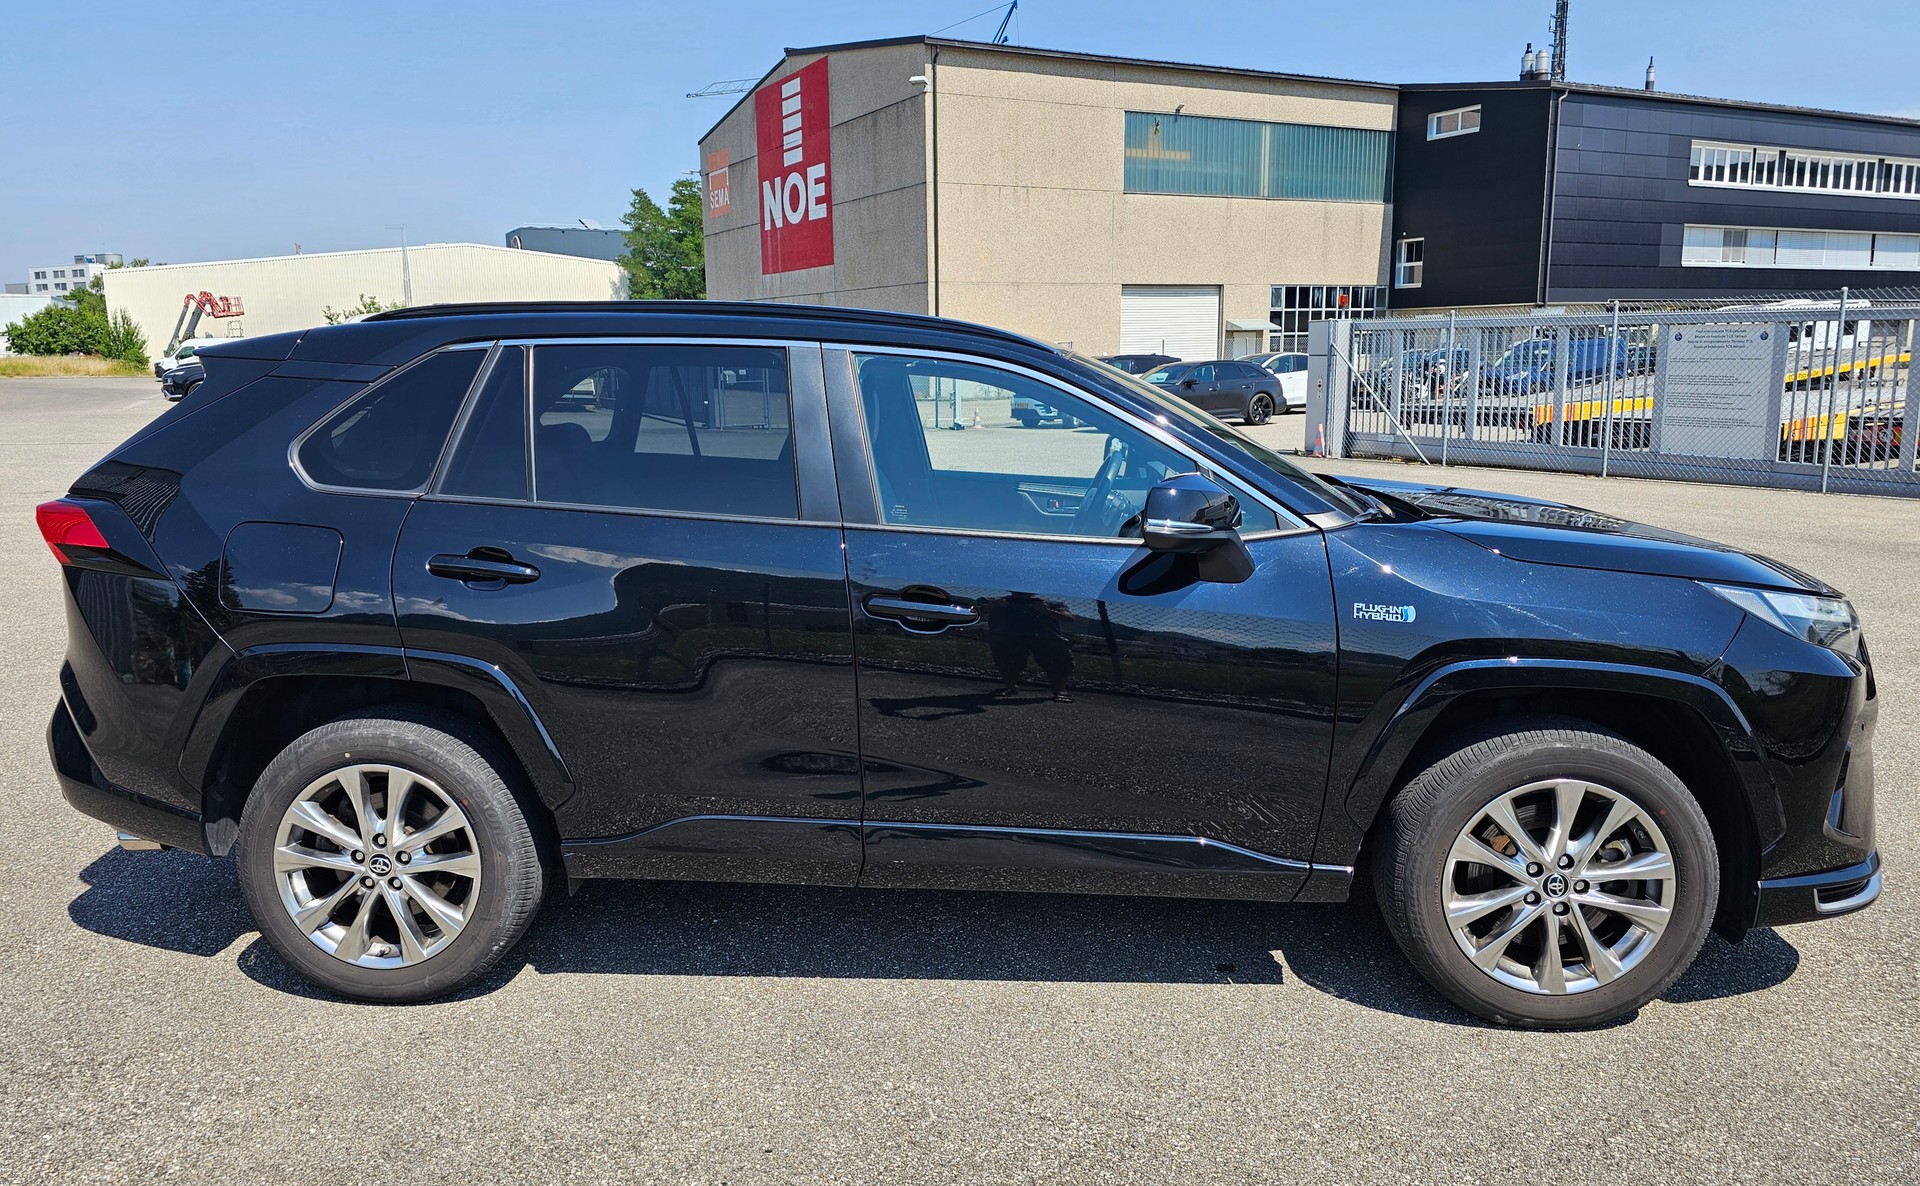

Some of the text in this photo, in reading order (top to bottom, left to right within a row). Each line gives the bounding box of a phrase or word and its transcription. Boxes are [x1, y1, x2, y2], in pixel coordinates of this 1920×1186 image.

[710, 187, 729, 208] SEMA
[763, 163, 827, 230] NOE
[1353, 603, 1402, 613] PLUG-IN
[1353, 612, 1402, 621] HYBRID
